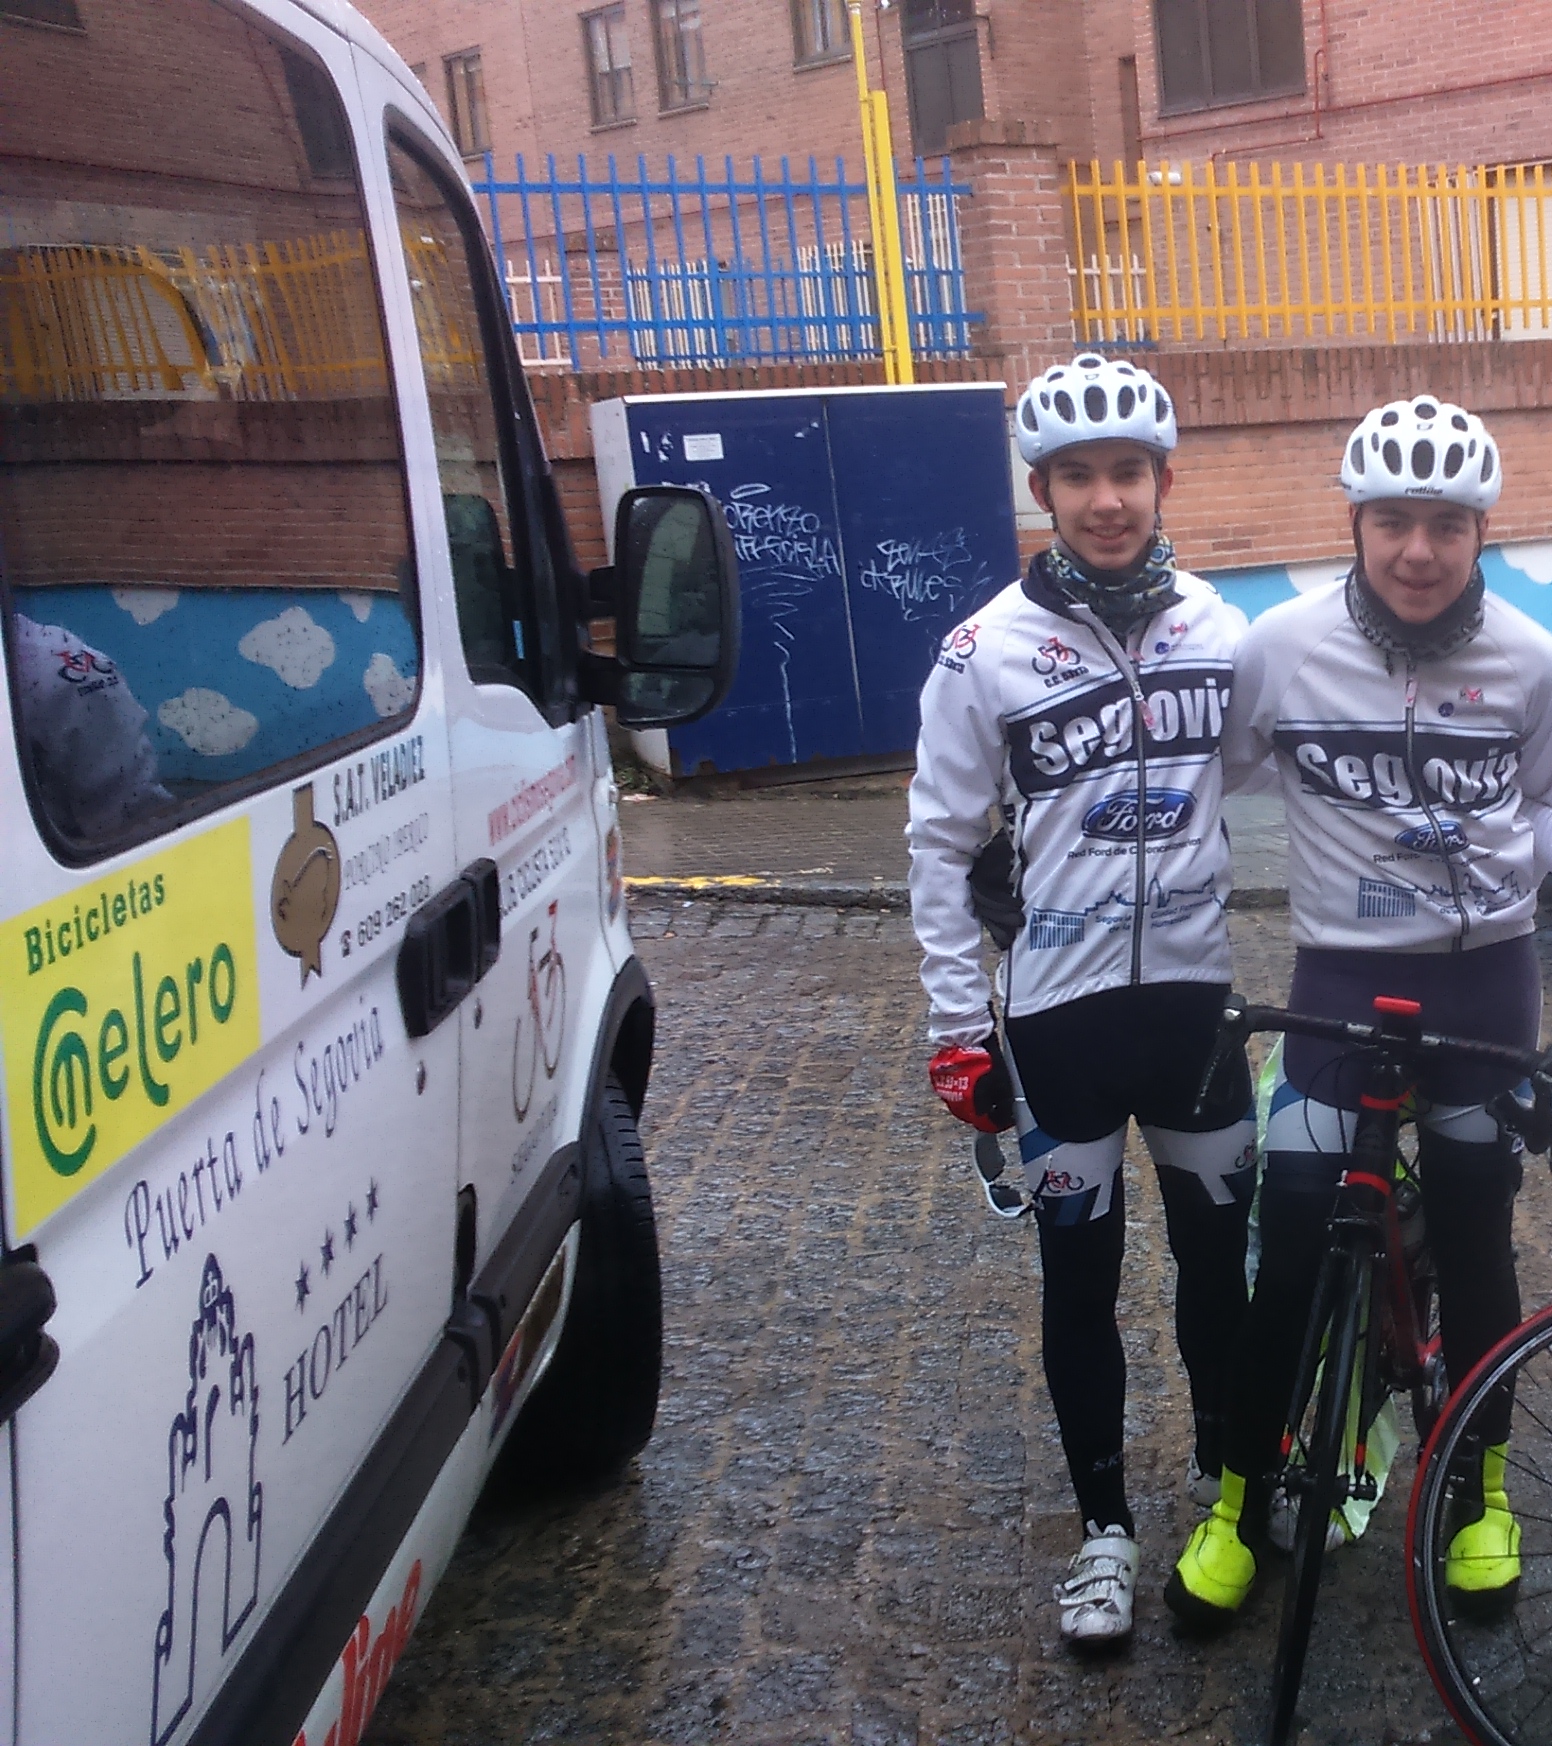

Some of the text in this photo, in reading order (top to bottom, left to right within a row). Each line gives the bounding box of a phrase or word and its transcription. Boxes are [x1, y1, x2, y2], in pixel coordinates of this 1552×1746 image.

[1029, 678, 1230, 776] Segovi
[1088, 847, 1112, 857] Ford
[1097, 798, 1185, 831] Ford
[24, 874, 165, 976] Bicicletas
[124, 1131, 242, 1289] Puerta
[252, 1068, 284, 1175] de
[294, 995, 383, 1139] Segovia
[282, 1253, 388, 1446] HOTEL
